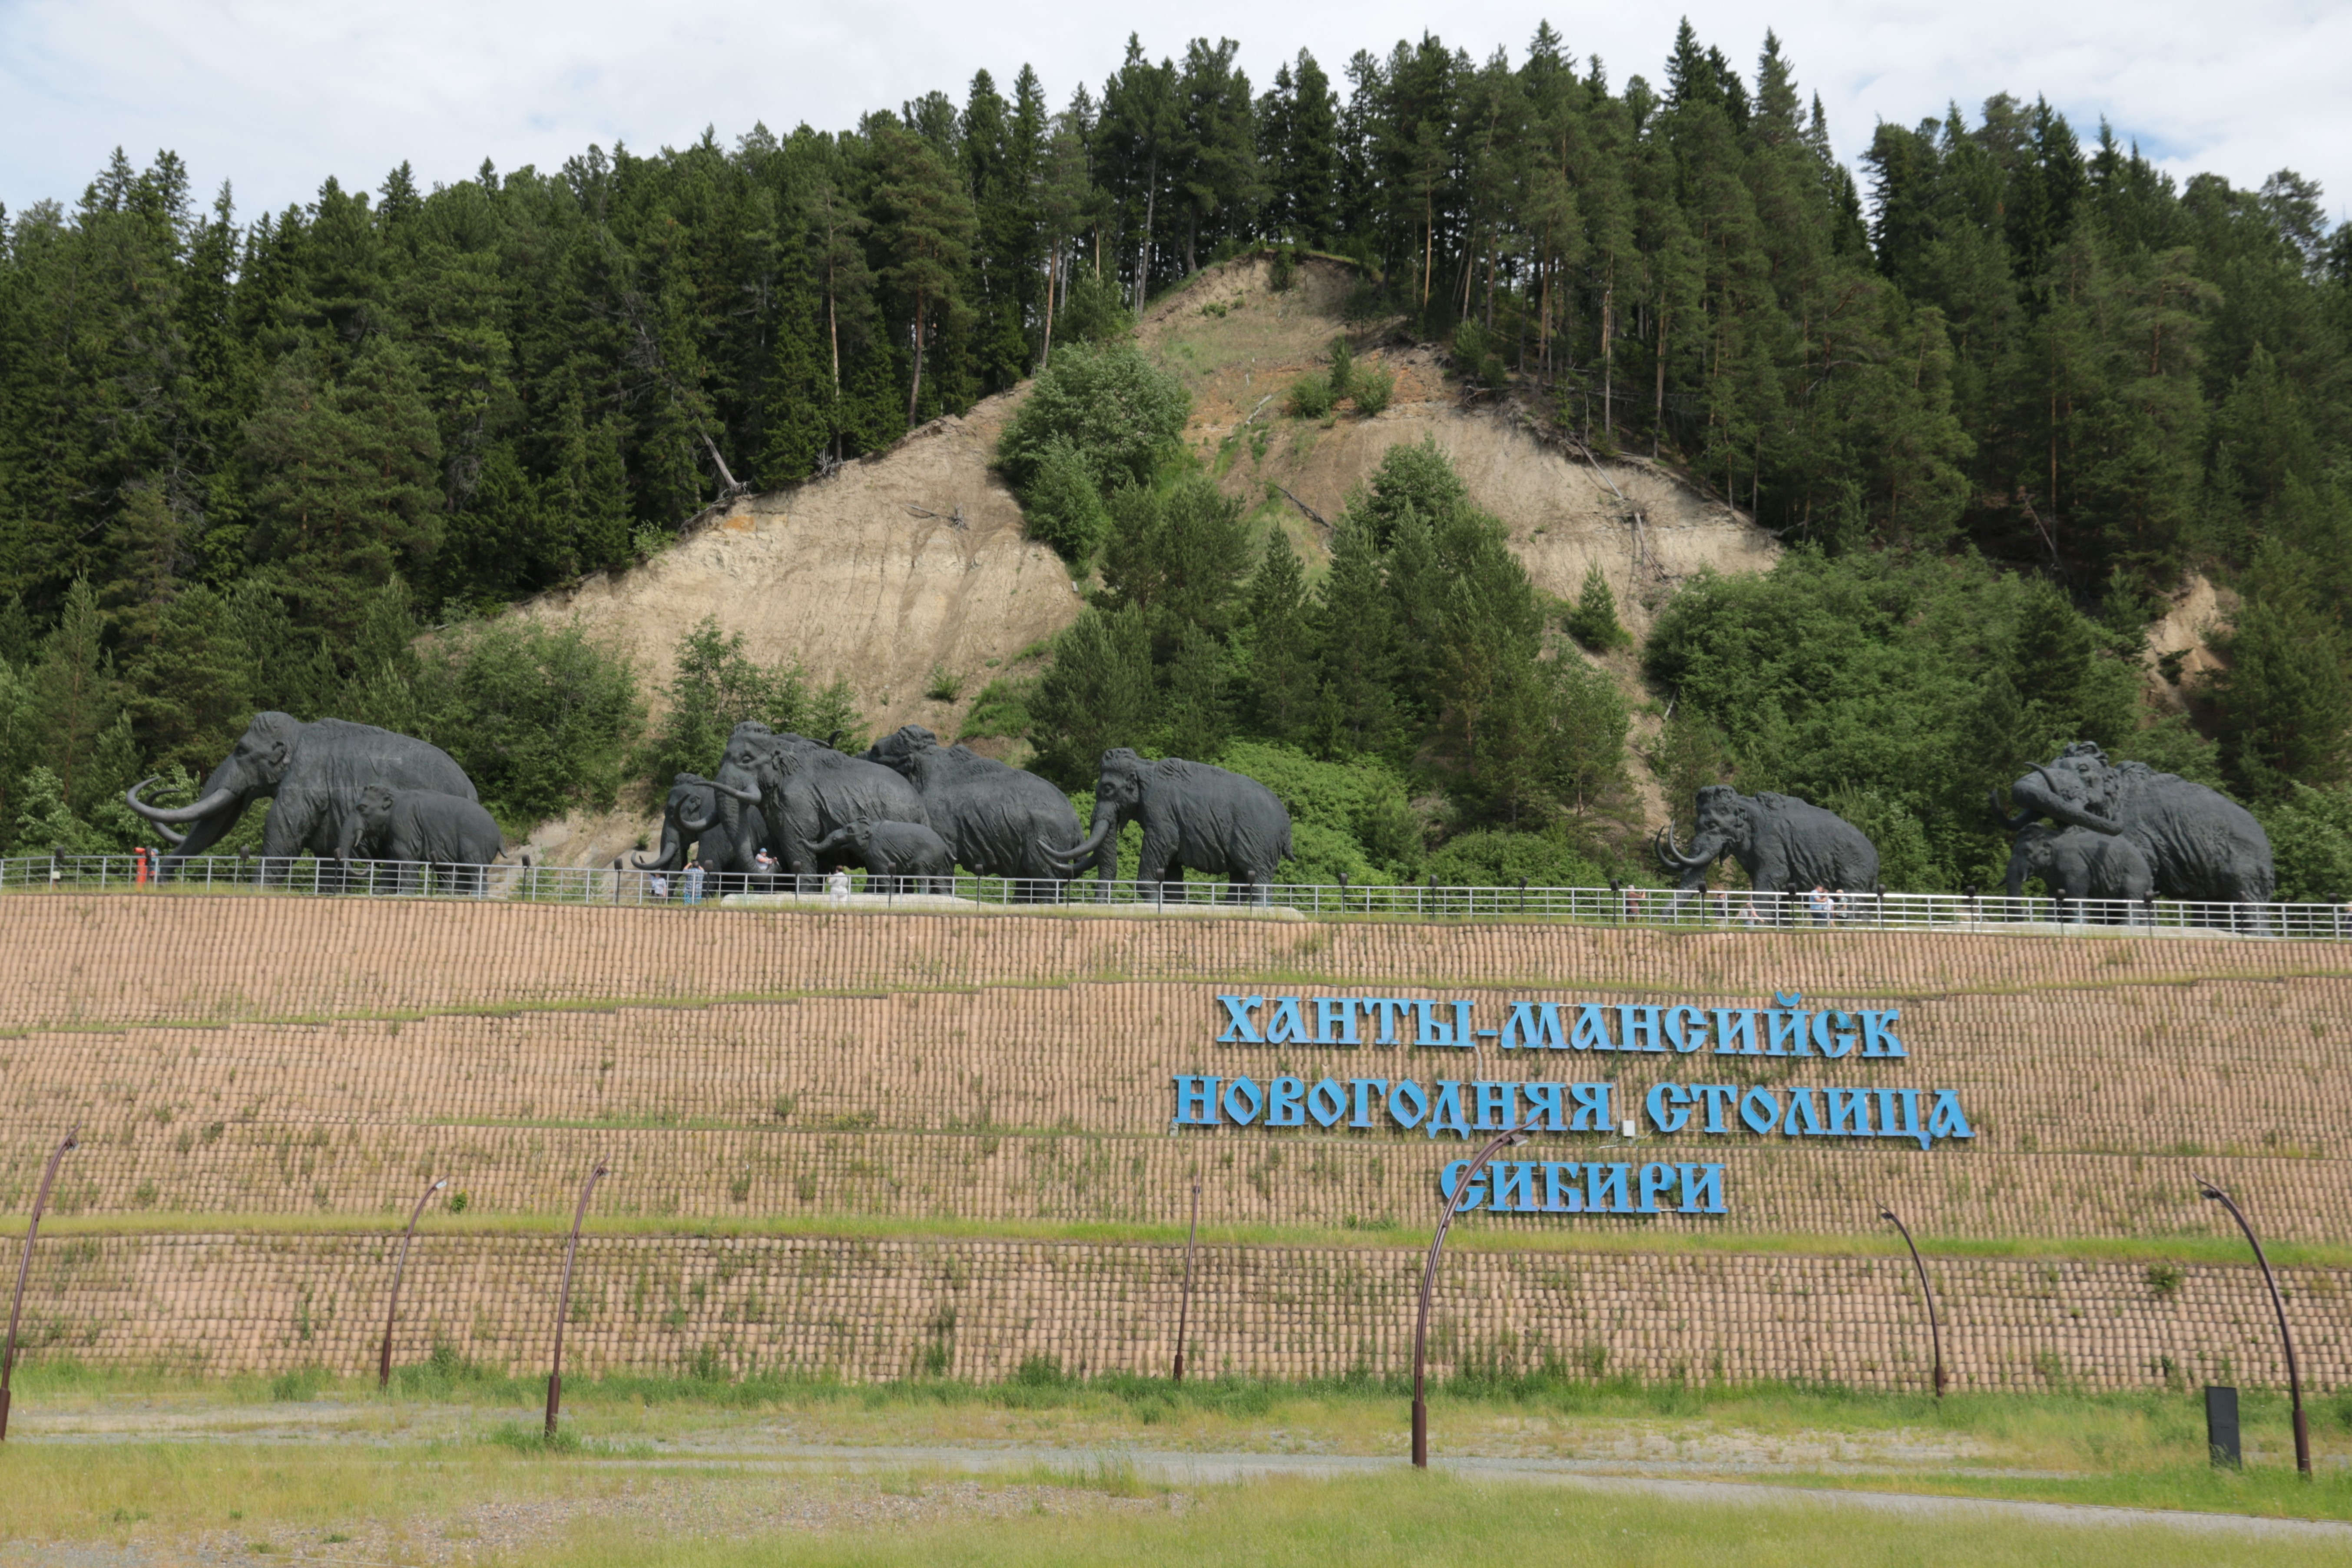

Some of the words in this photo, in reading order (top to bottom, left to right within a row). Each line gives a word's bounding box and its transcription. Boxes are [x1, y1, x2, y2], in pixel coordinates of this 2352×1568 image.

[1217, 991, 1909, 1058] ХАНТЫ-МАНСИЙСК
[1173, 1074, 1615, 1140] НОВОГОДНЯЯ
[1645, 1082, 1975, 1151] СТОЛИЦА
[1440, 1159, 1729, 1213] СИБИРИ
